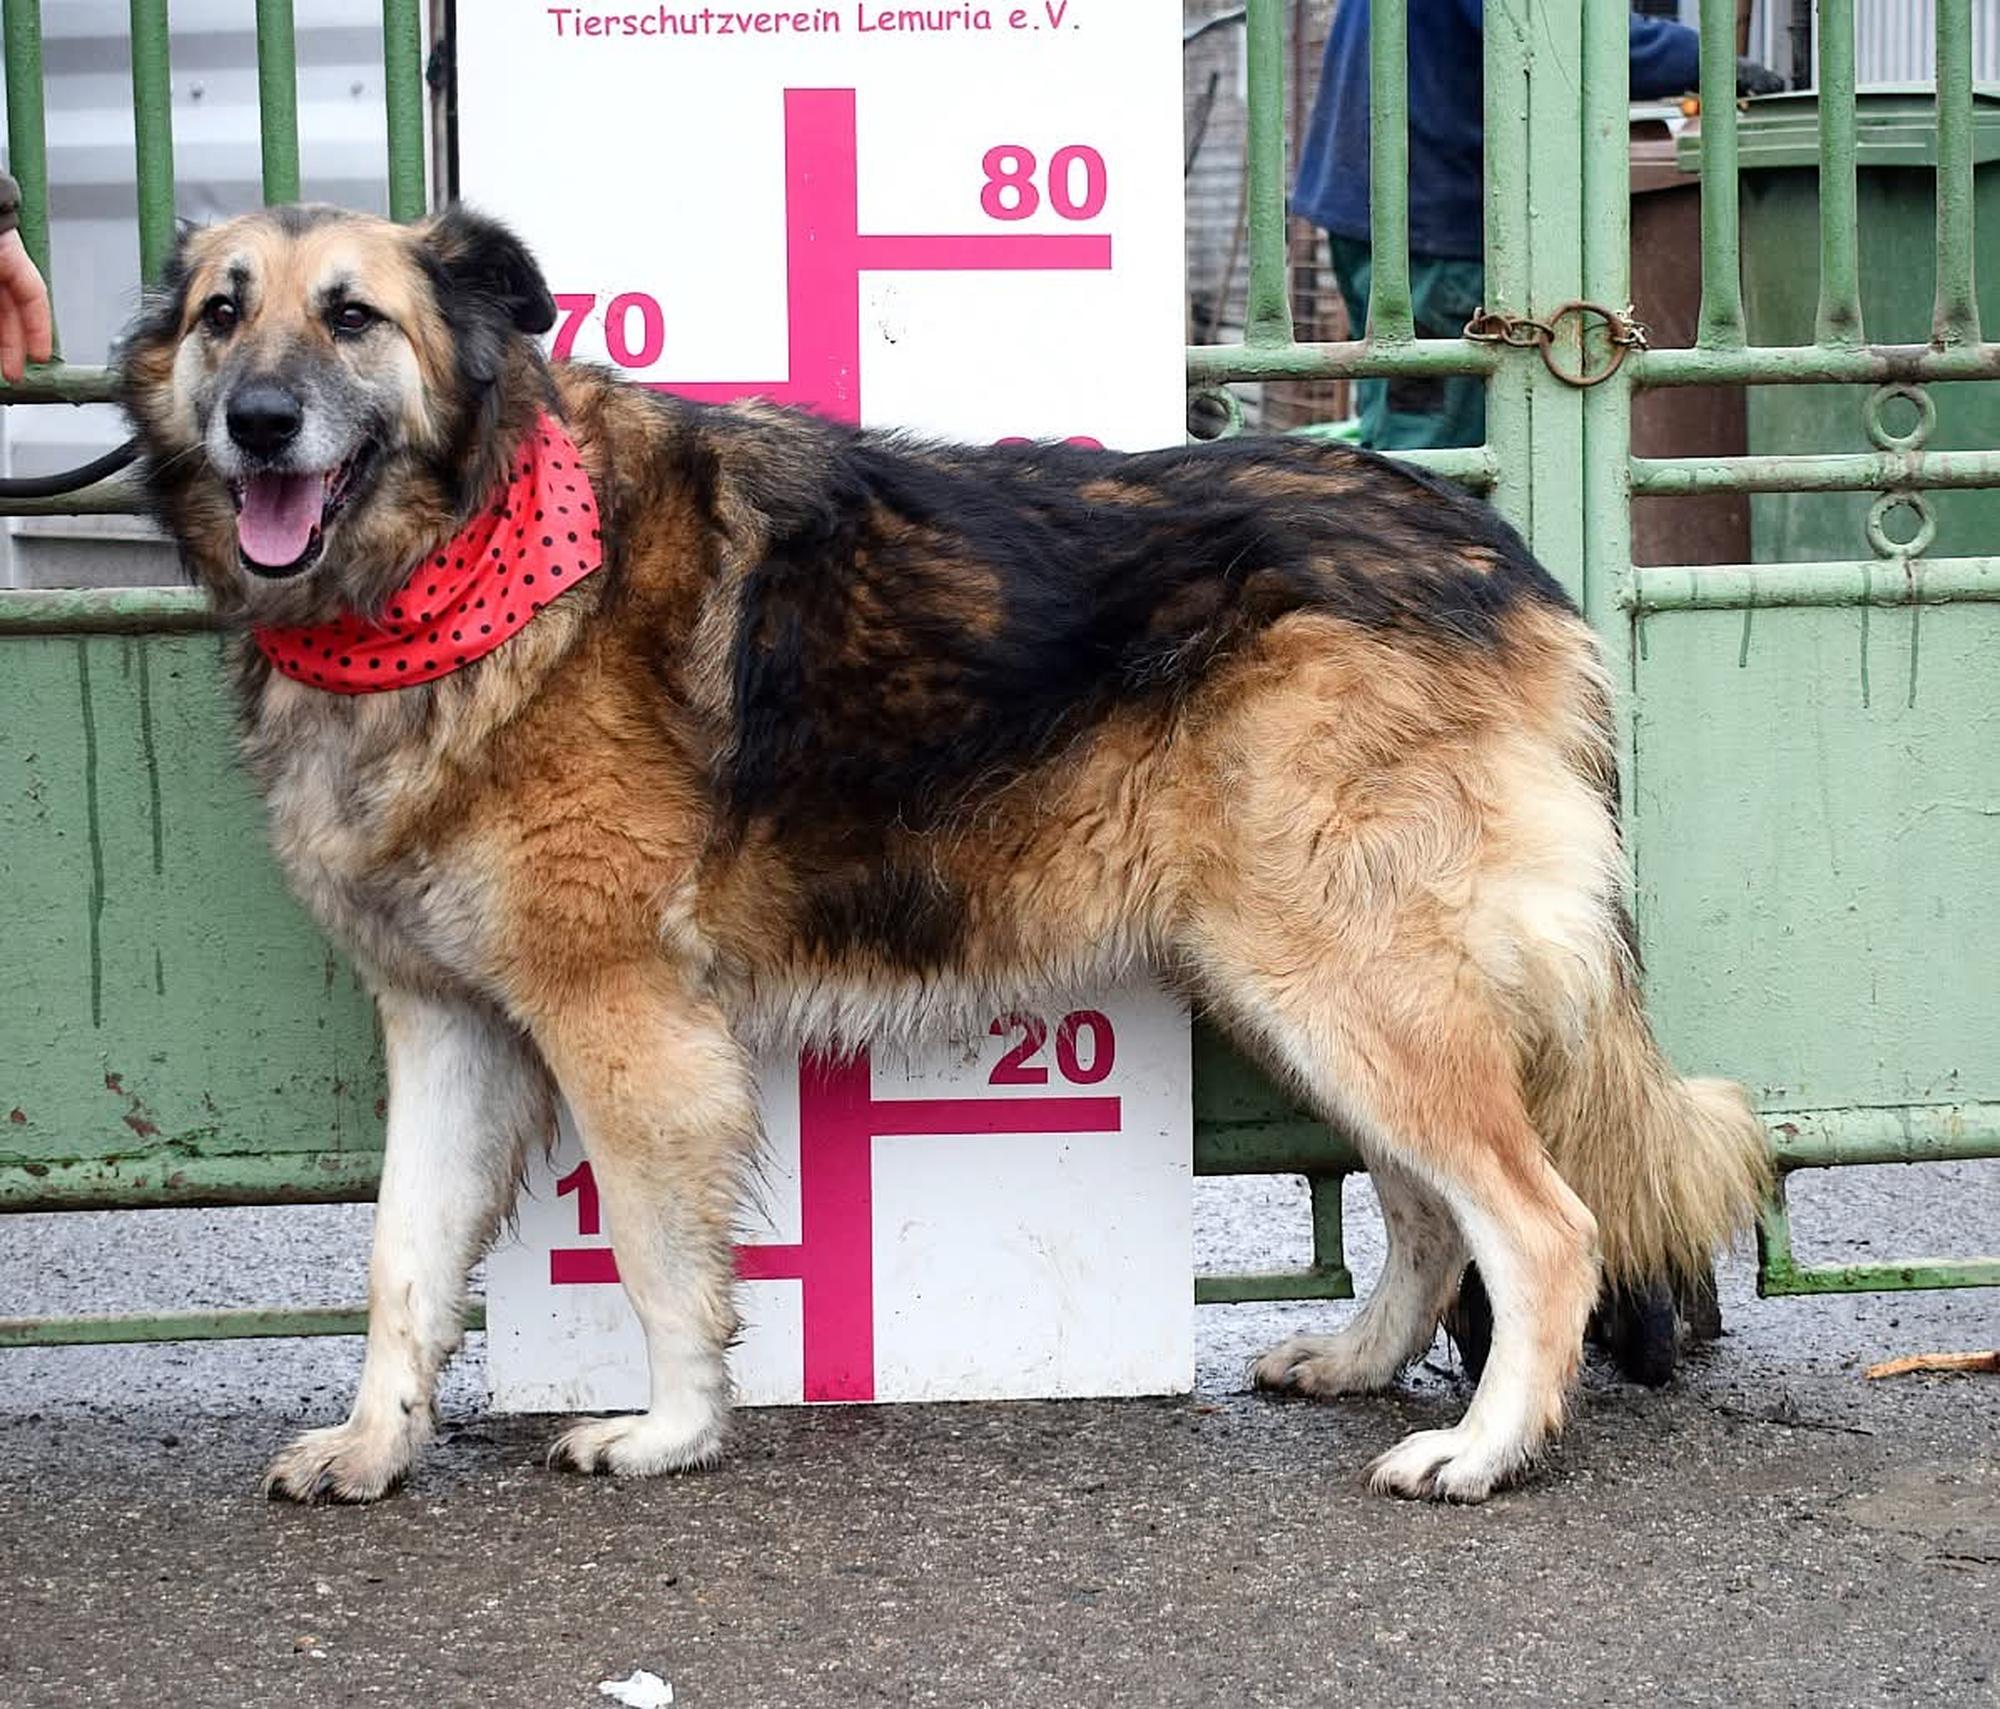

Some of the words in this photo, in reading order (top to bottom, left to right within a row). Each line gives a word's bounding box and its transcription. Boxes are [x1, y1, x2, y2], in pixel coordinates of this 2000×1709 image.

[547, 4, 840, 37] Tierschutzverein
[857, 3, 992, 33] Lemuria
[1007, 0, 1081, 31] e.V.
[980, 144, 1108, 222] 80
[550, 292, 666, 369] 70
[988, 1009, 1116, 1085] 20
[556, 1161, 600, 1236] 1
